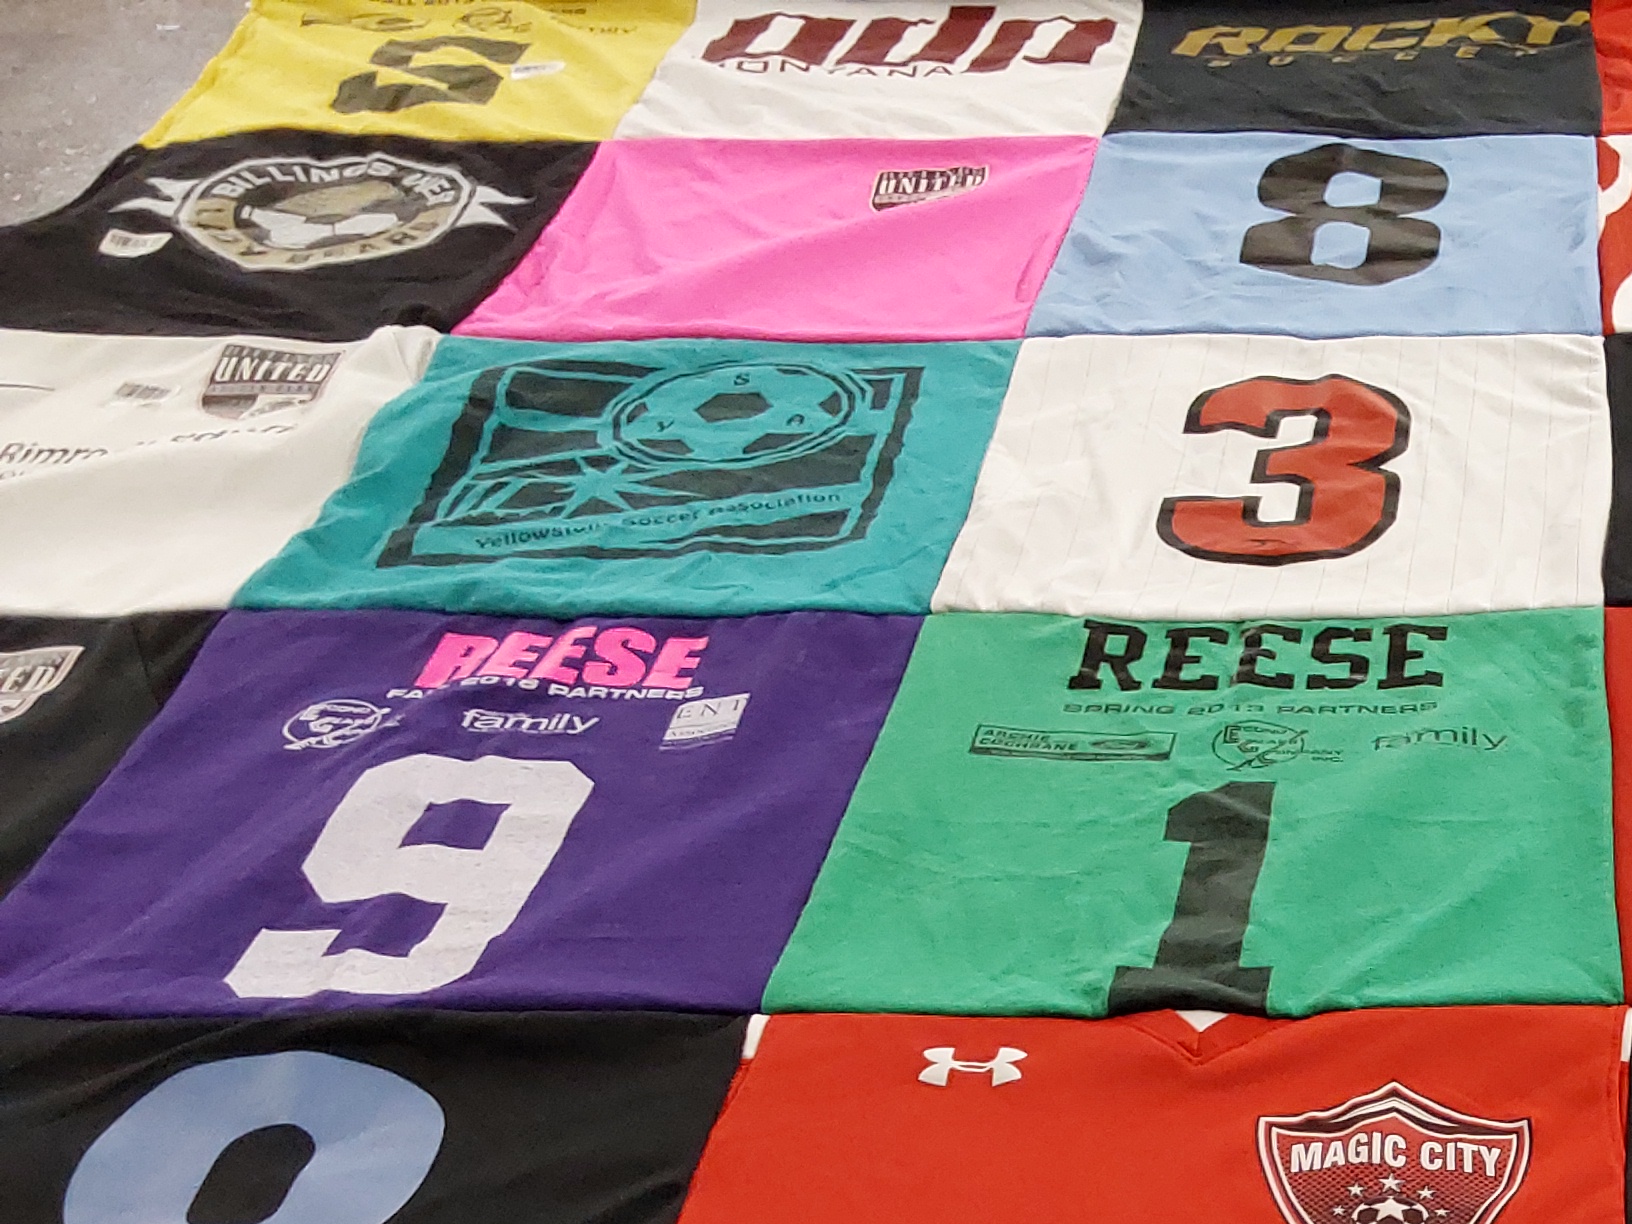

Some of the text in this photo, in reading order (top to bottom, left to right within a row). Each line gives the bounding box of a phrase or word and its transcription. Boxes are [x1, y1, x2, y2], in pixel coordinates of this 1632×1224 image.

[1171, 10, 1591, 58] ROCKY
[1239, 143, 1450, 287] 8
[214, 357, 333, 382] UNITED
[1155, 373, 1412, 567] 3
[413, 625, 710, 689] REESE
[1066, 618, 1450, 692] REESE
[460, 708, 601, 734] family
[547, 686, 705, 700] PARTNERS
[1063, 703, 1176, 715] SPRING
[1277, 701, 1438, 715] PARTNERS
[223, 752, 596, 999] 9
[1106, 780, 1277, 1016] 1
[1290, 1131, 1502, 1178] MAGIC CITY
